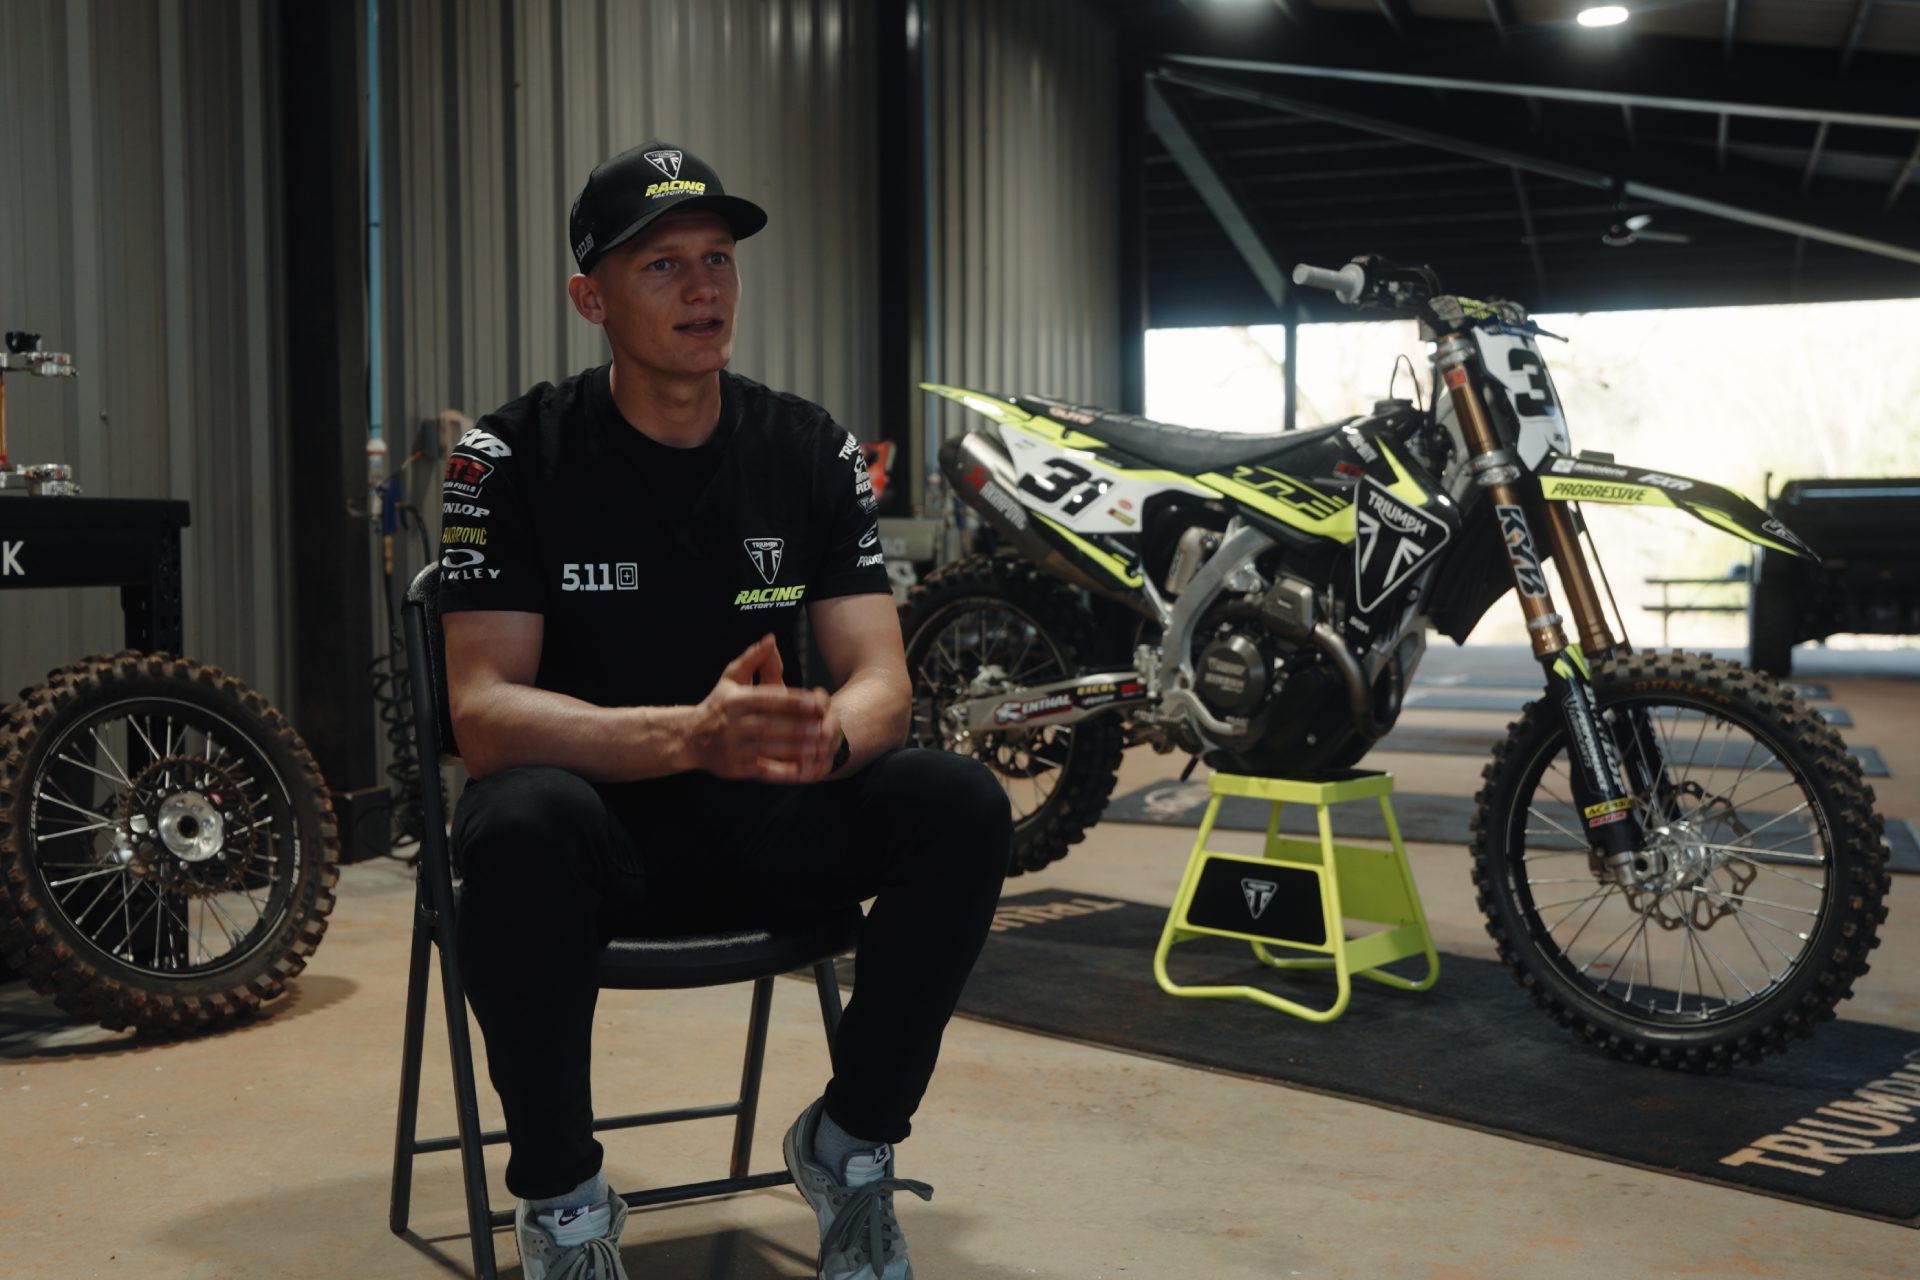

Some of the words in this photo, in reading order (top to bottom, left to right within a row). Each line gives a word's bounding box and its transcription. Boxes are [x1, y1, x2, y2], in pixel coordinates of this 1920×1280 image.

[645, 181, 706, 197] RACING
[1018, 458, 1114, 517] 31
[1551, 482, 1647, 501] PROGRESSIVE
[1368, 490, 1428, 537] TRIUMPH
[752, 541, 779, 551] TRIUMPH
[561, 563, 614, 591] 5.11
[734, 585, 806, 605] RACING
[740, 602, 775, 611] FACTORY
